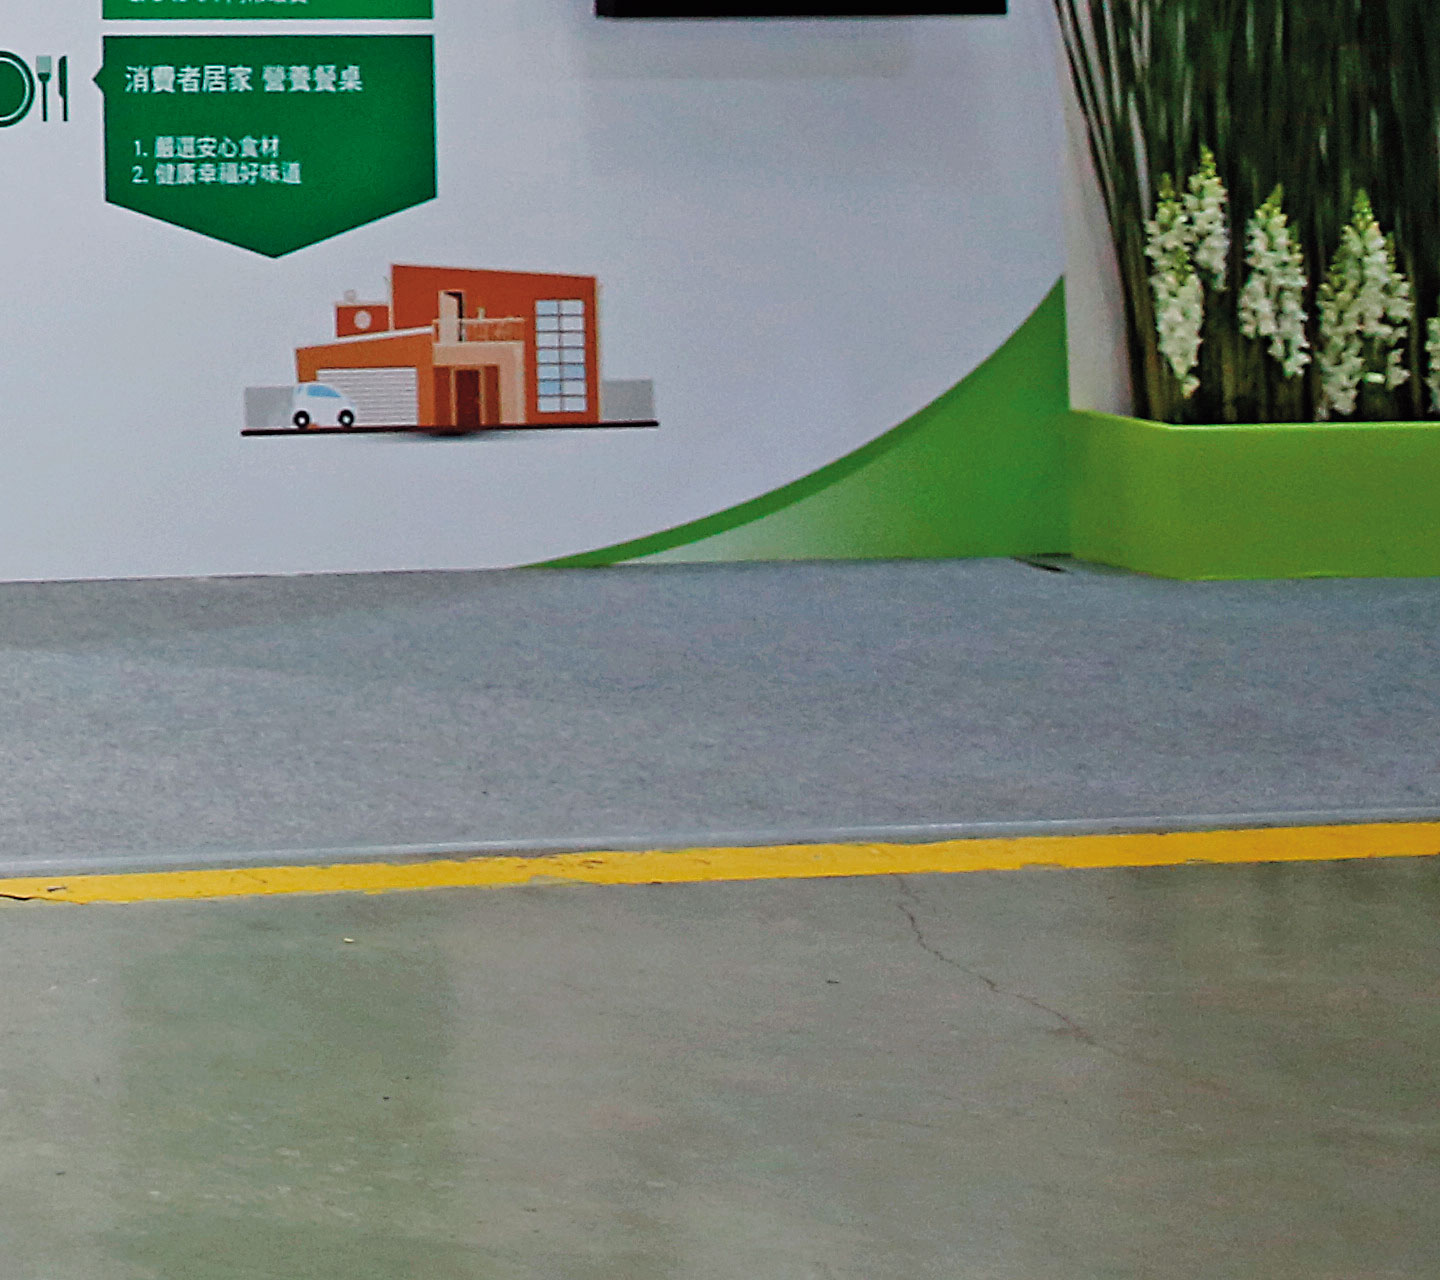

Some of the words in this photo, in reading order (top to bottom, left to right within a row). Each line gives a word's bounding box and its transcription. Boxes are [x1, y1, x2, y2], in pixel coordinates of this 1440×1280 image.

[126, 64, 253, 93] 消費者居家
